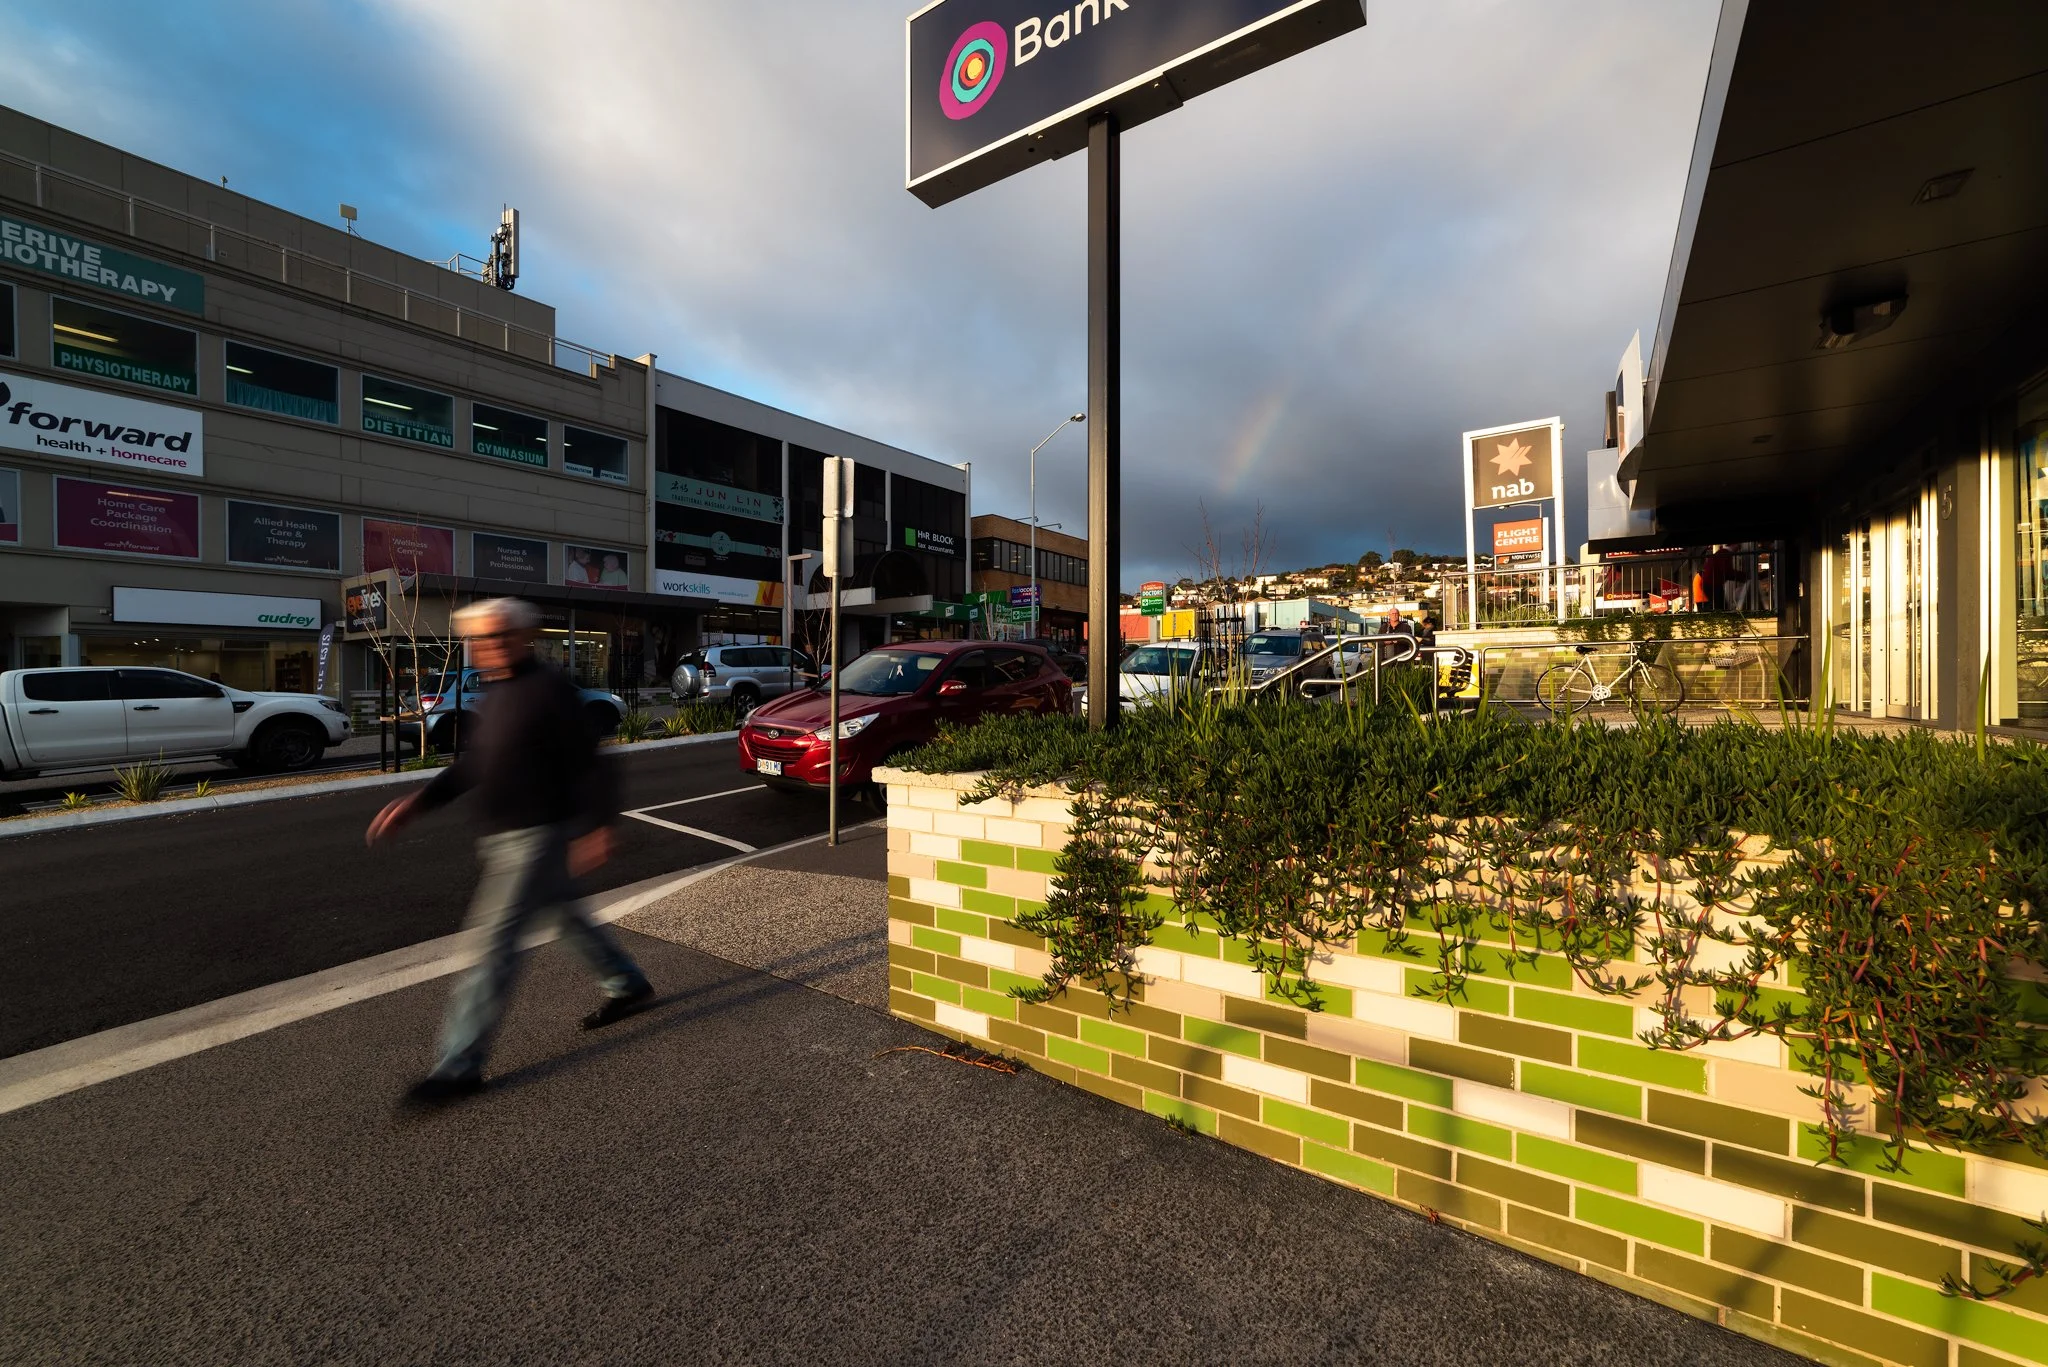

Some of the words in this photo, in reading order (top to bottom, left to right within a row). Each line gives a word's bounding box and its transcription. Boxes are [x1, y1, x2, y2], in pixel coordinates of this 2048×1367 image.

[0, 238, 176, 303] IOTHERAPY
[60, 351, 191, 391] PHYSIOTHERAPY
[8, 401, 192, 453] forward
[364, 416, 452, 446] DIETITIAN
[36, 434, 92, 453] health
[111, 446, 187, 468] homecare
[476, 441, 544, 465] GYMNASIUM
[1491, 478, 1535, 500] nab
[695, 487, 727, 500] JUN
[736, 495, 761, 507] LIN
[1941, 483, 1953, 521] 5
[97, 497, 136, 510] Home
[138, 502, 166, 514] Care
[106, 509, 158, 523] Package
[90, 517, 172, 534] Coordination
[253, 517, 283, 527] Allied
[285, 520, 318, 531] Health
[270, 528, 293, 537] Care
[294, 530, 304, 538] &
[932, 533, 953, 546] BLOCK
[1497, 527, 1538, 538] FLIGHT
[266, 536, 307, 548] Therapy
[392, 538, 428, 549] Wellness
[1495, 535, 1539, 547] CENTRE
[397, 547, 423, 556] Centre
[496, 546, 520, 555] Nurses
[927, 544, 955, 555] accountants
[489, 560, 534, 571] Professionals
[501, 554, 524, 563] Health
[662, 581, 711, 594] workskills
[257, 613, 315, 627] audrey
